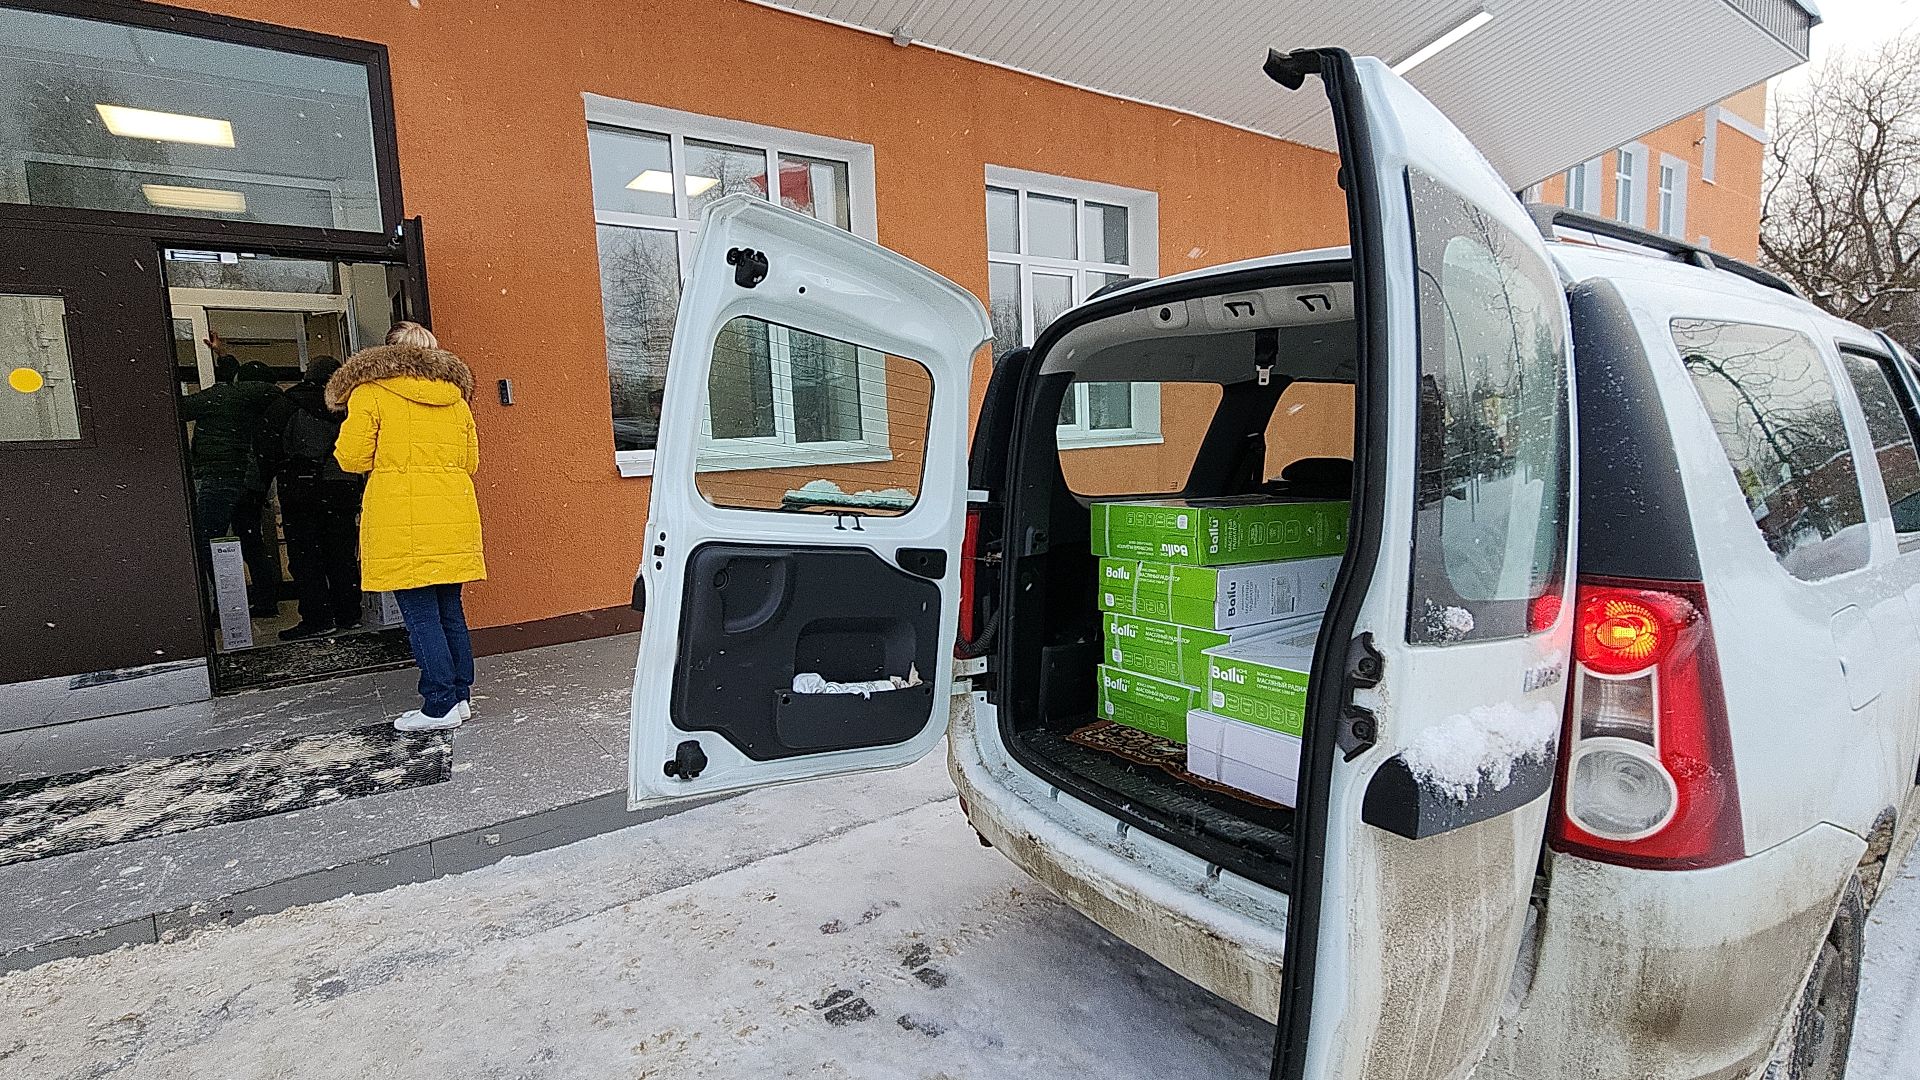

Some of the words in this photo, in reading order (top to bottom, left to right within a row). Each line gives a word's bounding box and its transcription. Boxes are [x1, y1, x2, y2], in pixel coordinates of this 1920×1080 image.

[1209, 519, 1219, 554] Ballu
[1161, 543, 1188, 558] Ballu
[1106, 566, 1130, 580] Ballu
[1227, 582, 1236, 617] Ballu
[1111, 623, 1136, 638] Ballu
[1212, 665, 1244, 685] Ballu
[1104, 676, 1128, 693] Ballu
